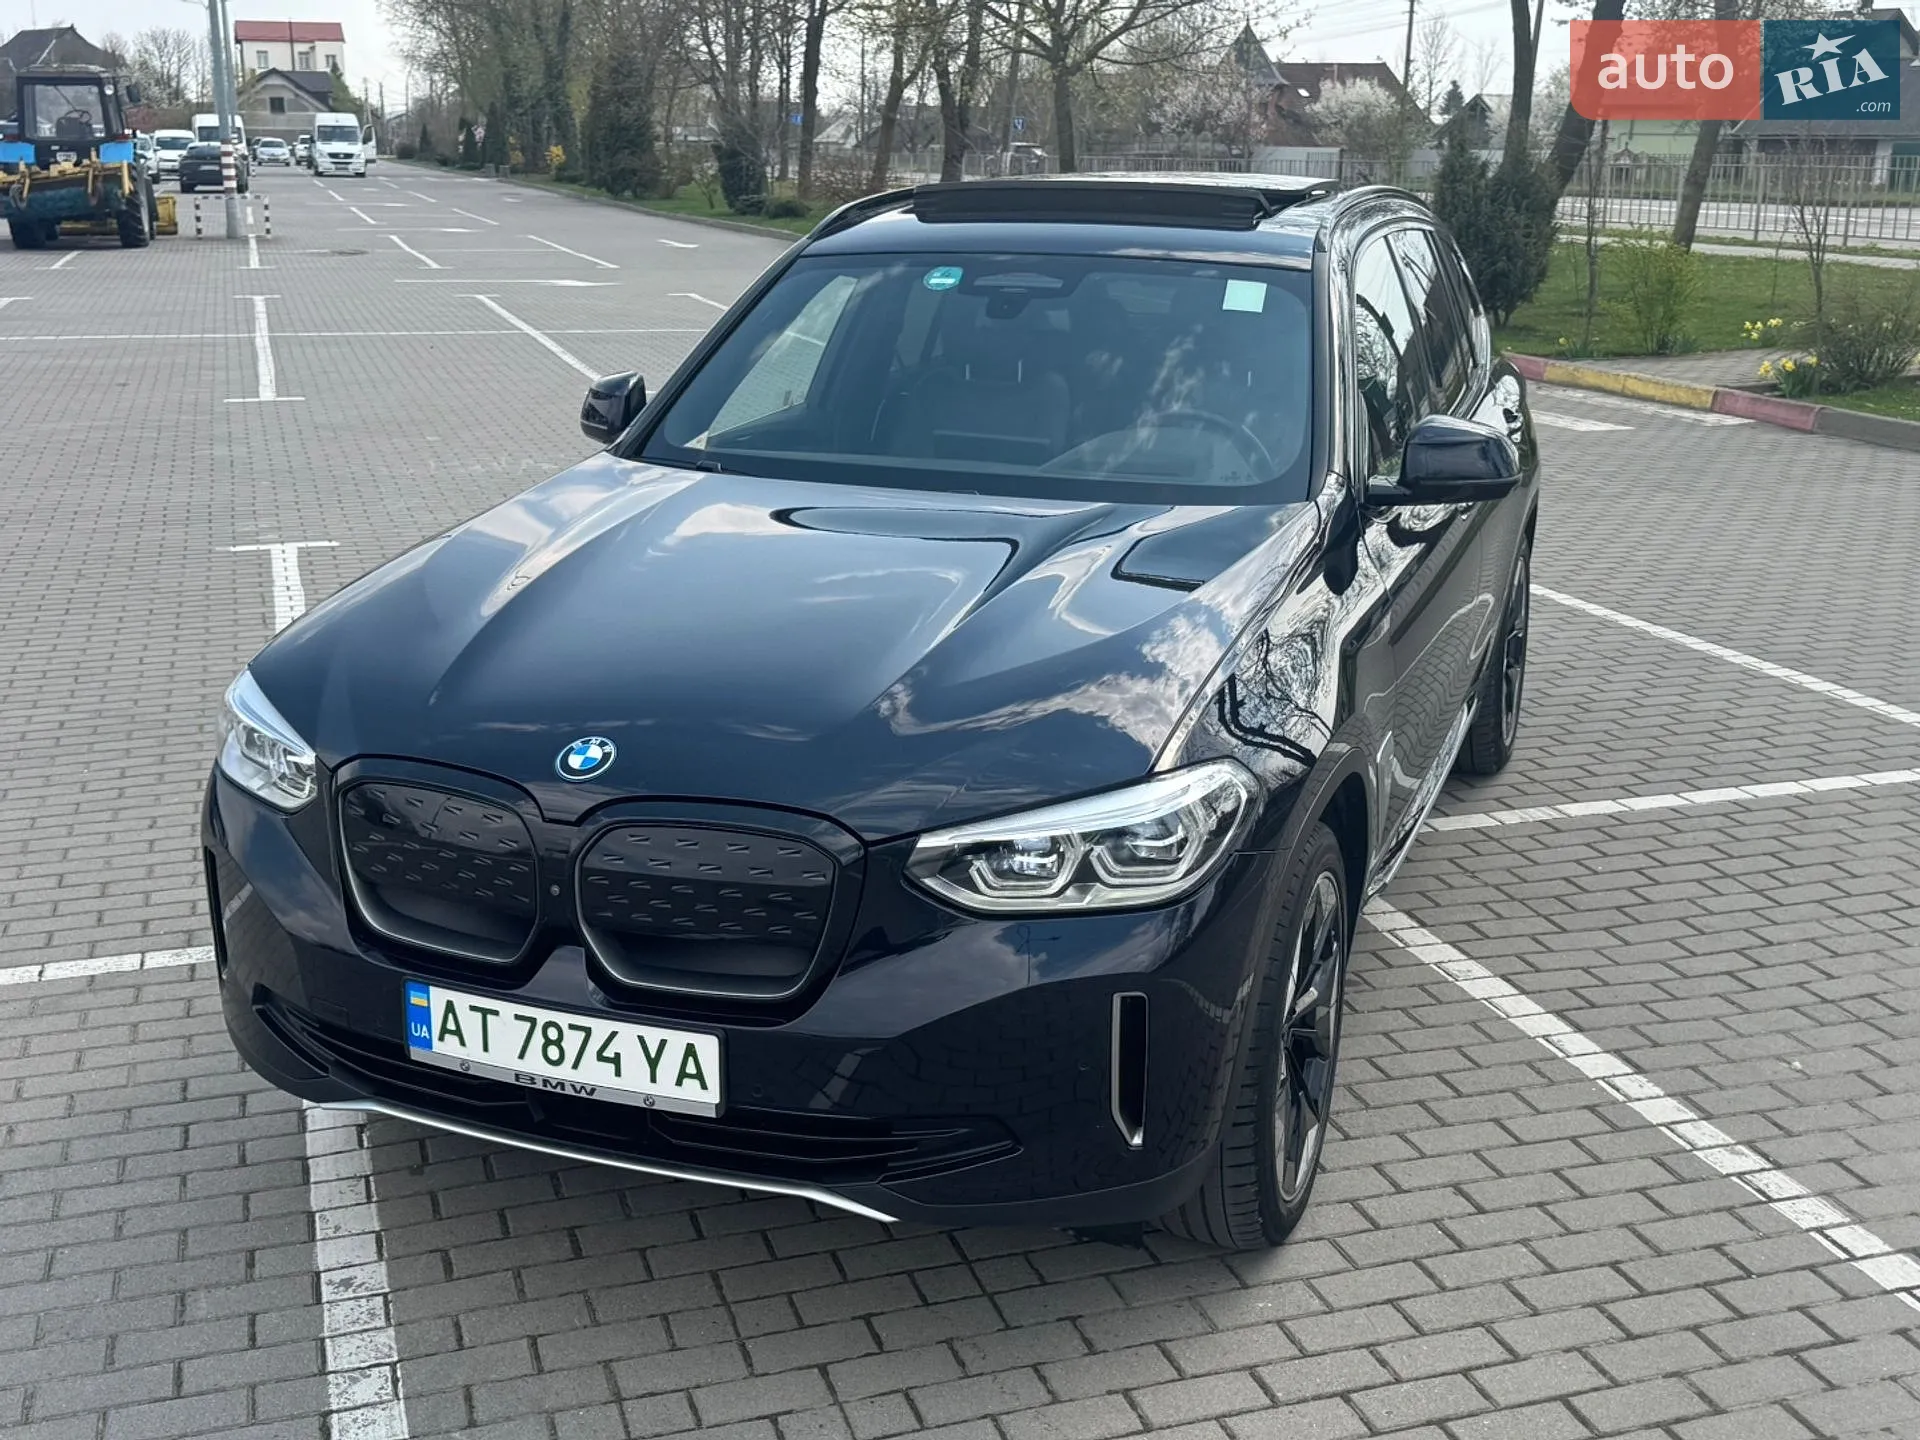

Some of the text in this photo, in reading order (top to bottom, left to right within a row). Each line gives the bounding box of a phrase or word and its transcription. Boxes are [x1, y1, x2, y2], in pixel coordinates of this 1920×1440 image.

[410, 1022, 430, 1039] UA
[437, 999, 709, 1091] AT 7874 YA
[514, 1072, 598, 1097] BMW
